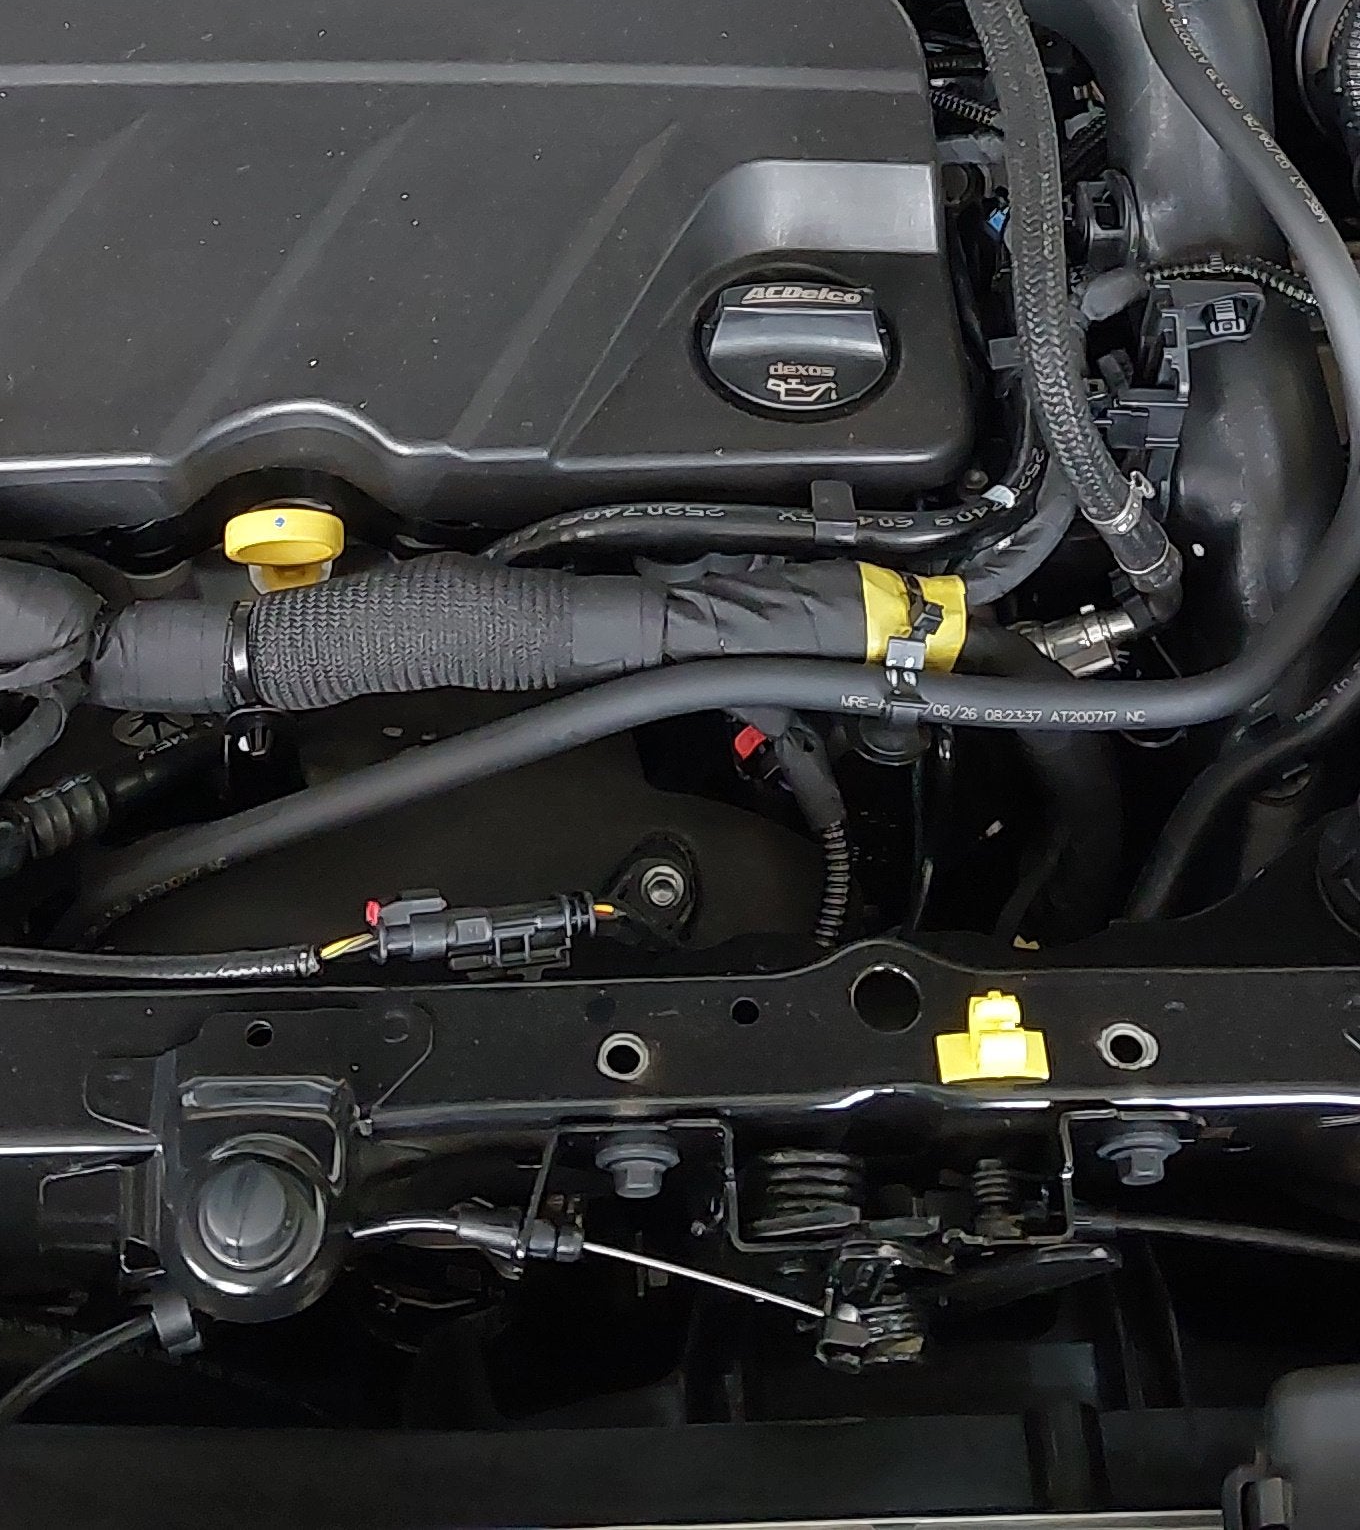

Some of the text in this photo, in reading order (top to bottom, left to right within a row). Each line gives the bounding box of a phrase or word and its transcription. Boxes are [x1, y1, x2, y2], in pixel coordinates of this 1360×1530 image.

[745, 286, 862, 304] ACDelco
[768, 361, 837, 376] dexos
[1050, 711, 1117, 724] AT200717
[1124, 710, 1146, 723] NC
